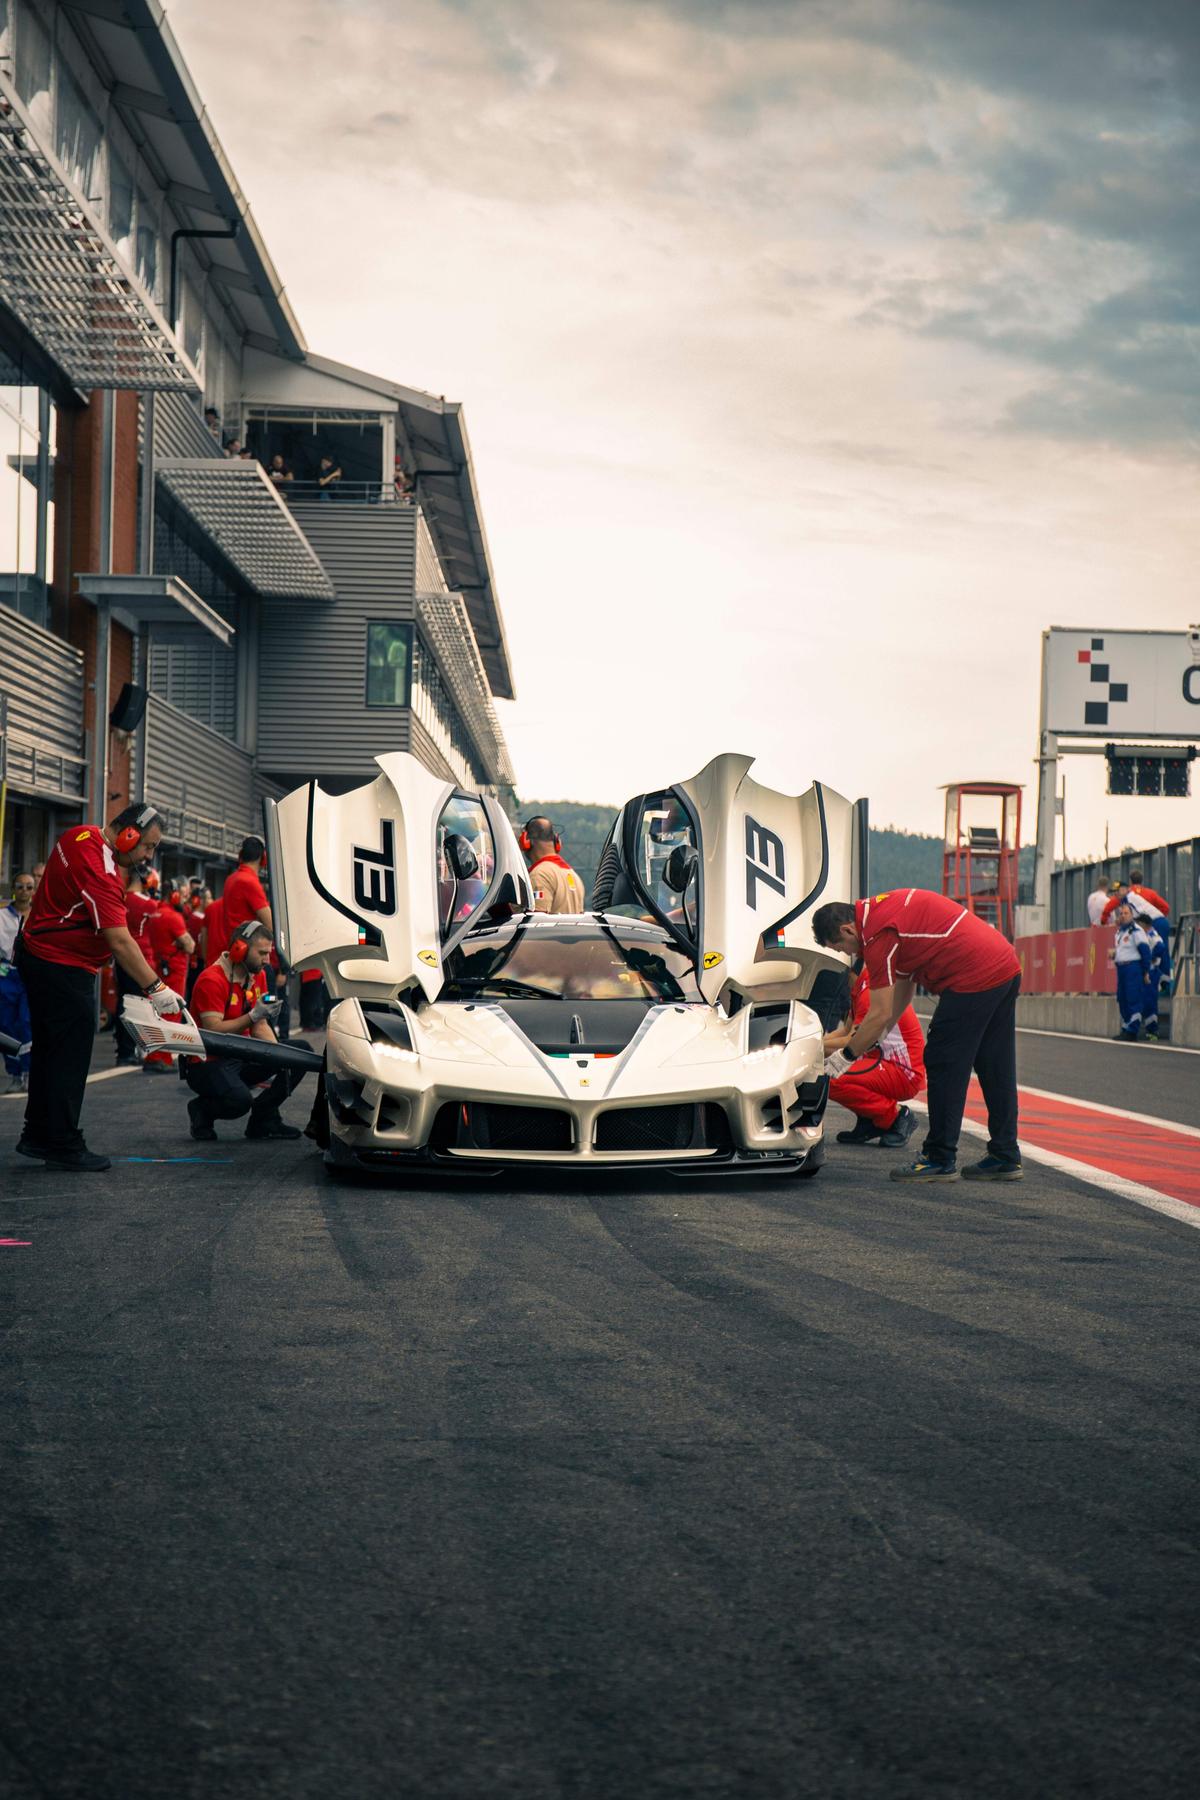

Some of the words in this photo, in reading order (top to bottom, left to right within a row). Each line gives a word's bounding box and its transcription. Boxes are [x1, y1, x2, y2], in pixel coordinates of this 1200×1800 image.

[352, 820, 397, 917] 73
[745, 815, 786, 912] 73
[171, 1032, 194, 1043] STIHL
